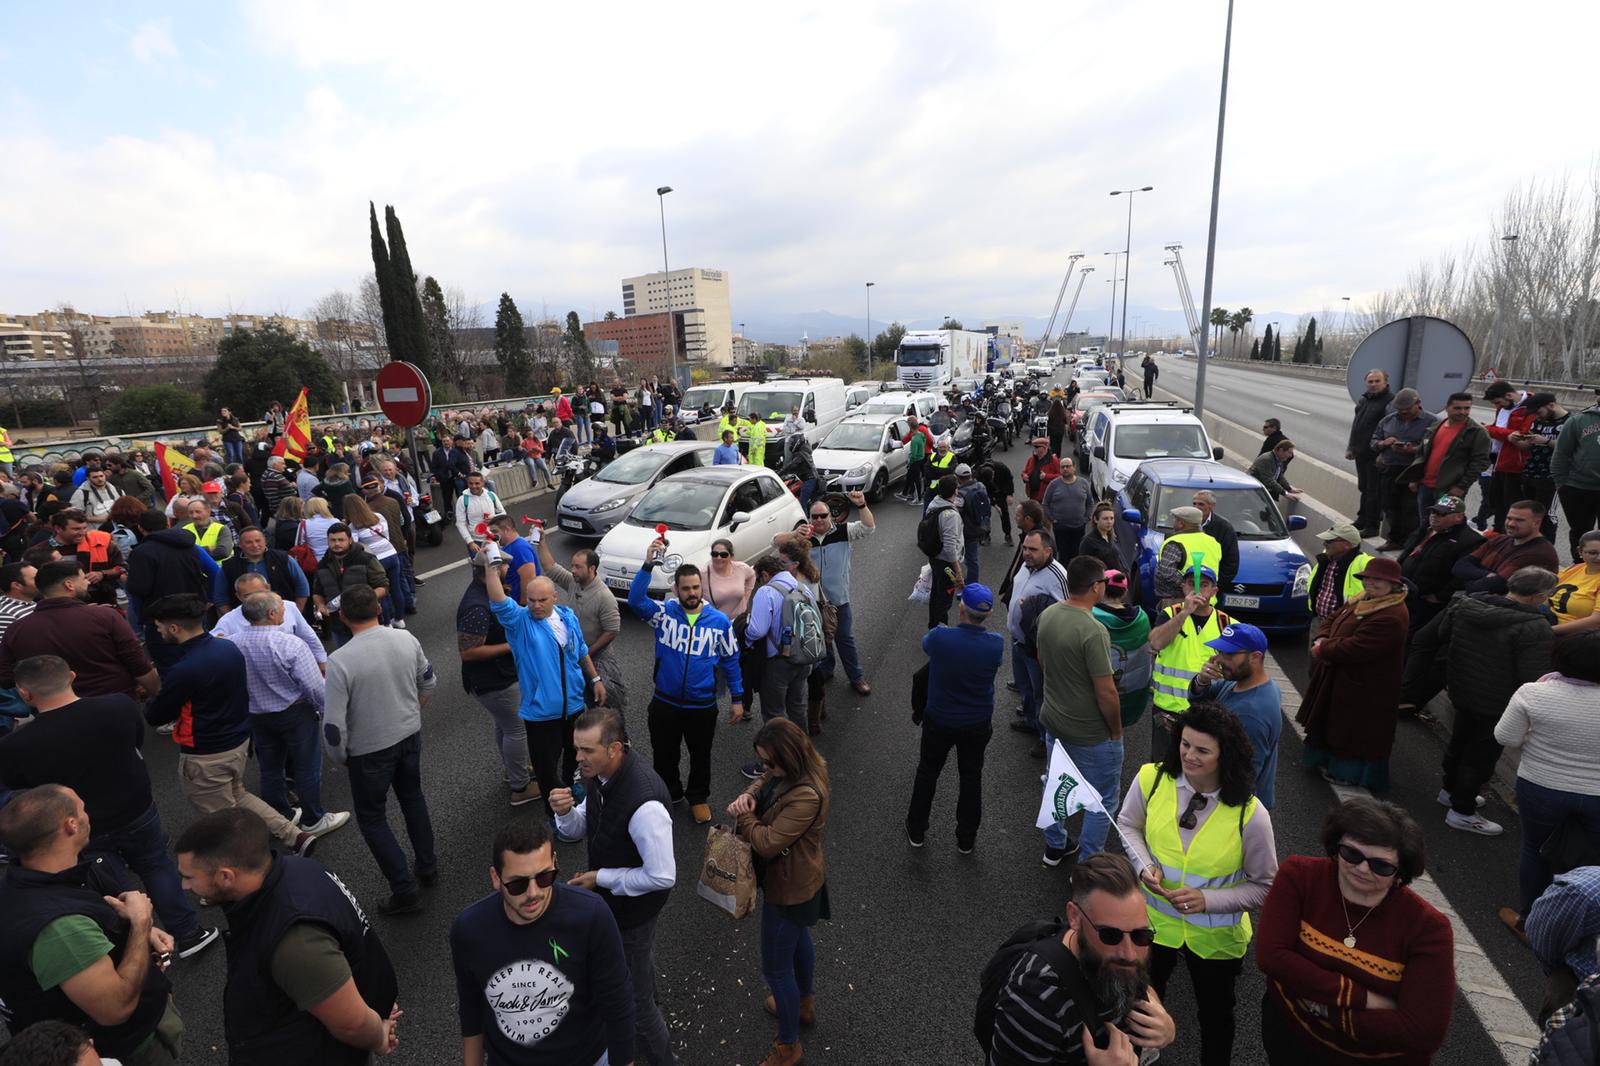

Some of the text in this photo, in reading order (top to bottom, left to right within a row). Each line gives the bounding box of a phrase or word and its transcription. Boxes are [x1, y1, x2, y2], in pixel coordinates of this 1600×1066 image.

[489, 967, 513, 989] KEEP
[521, 964, 532, 972] IT
[517, 1017, 543, 1026] 1990
[533, 1005, 568, 1040] GOODS
